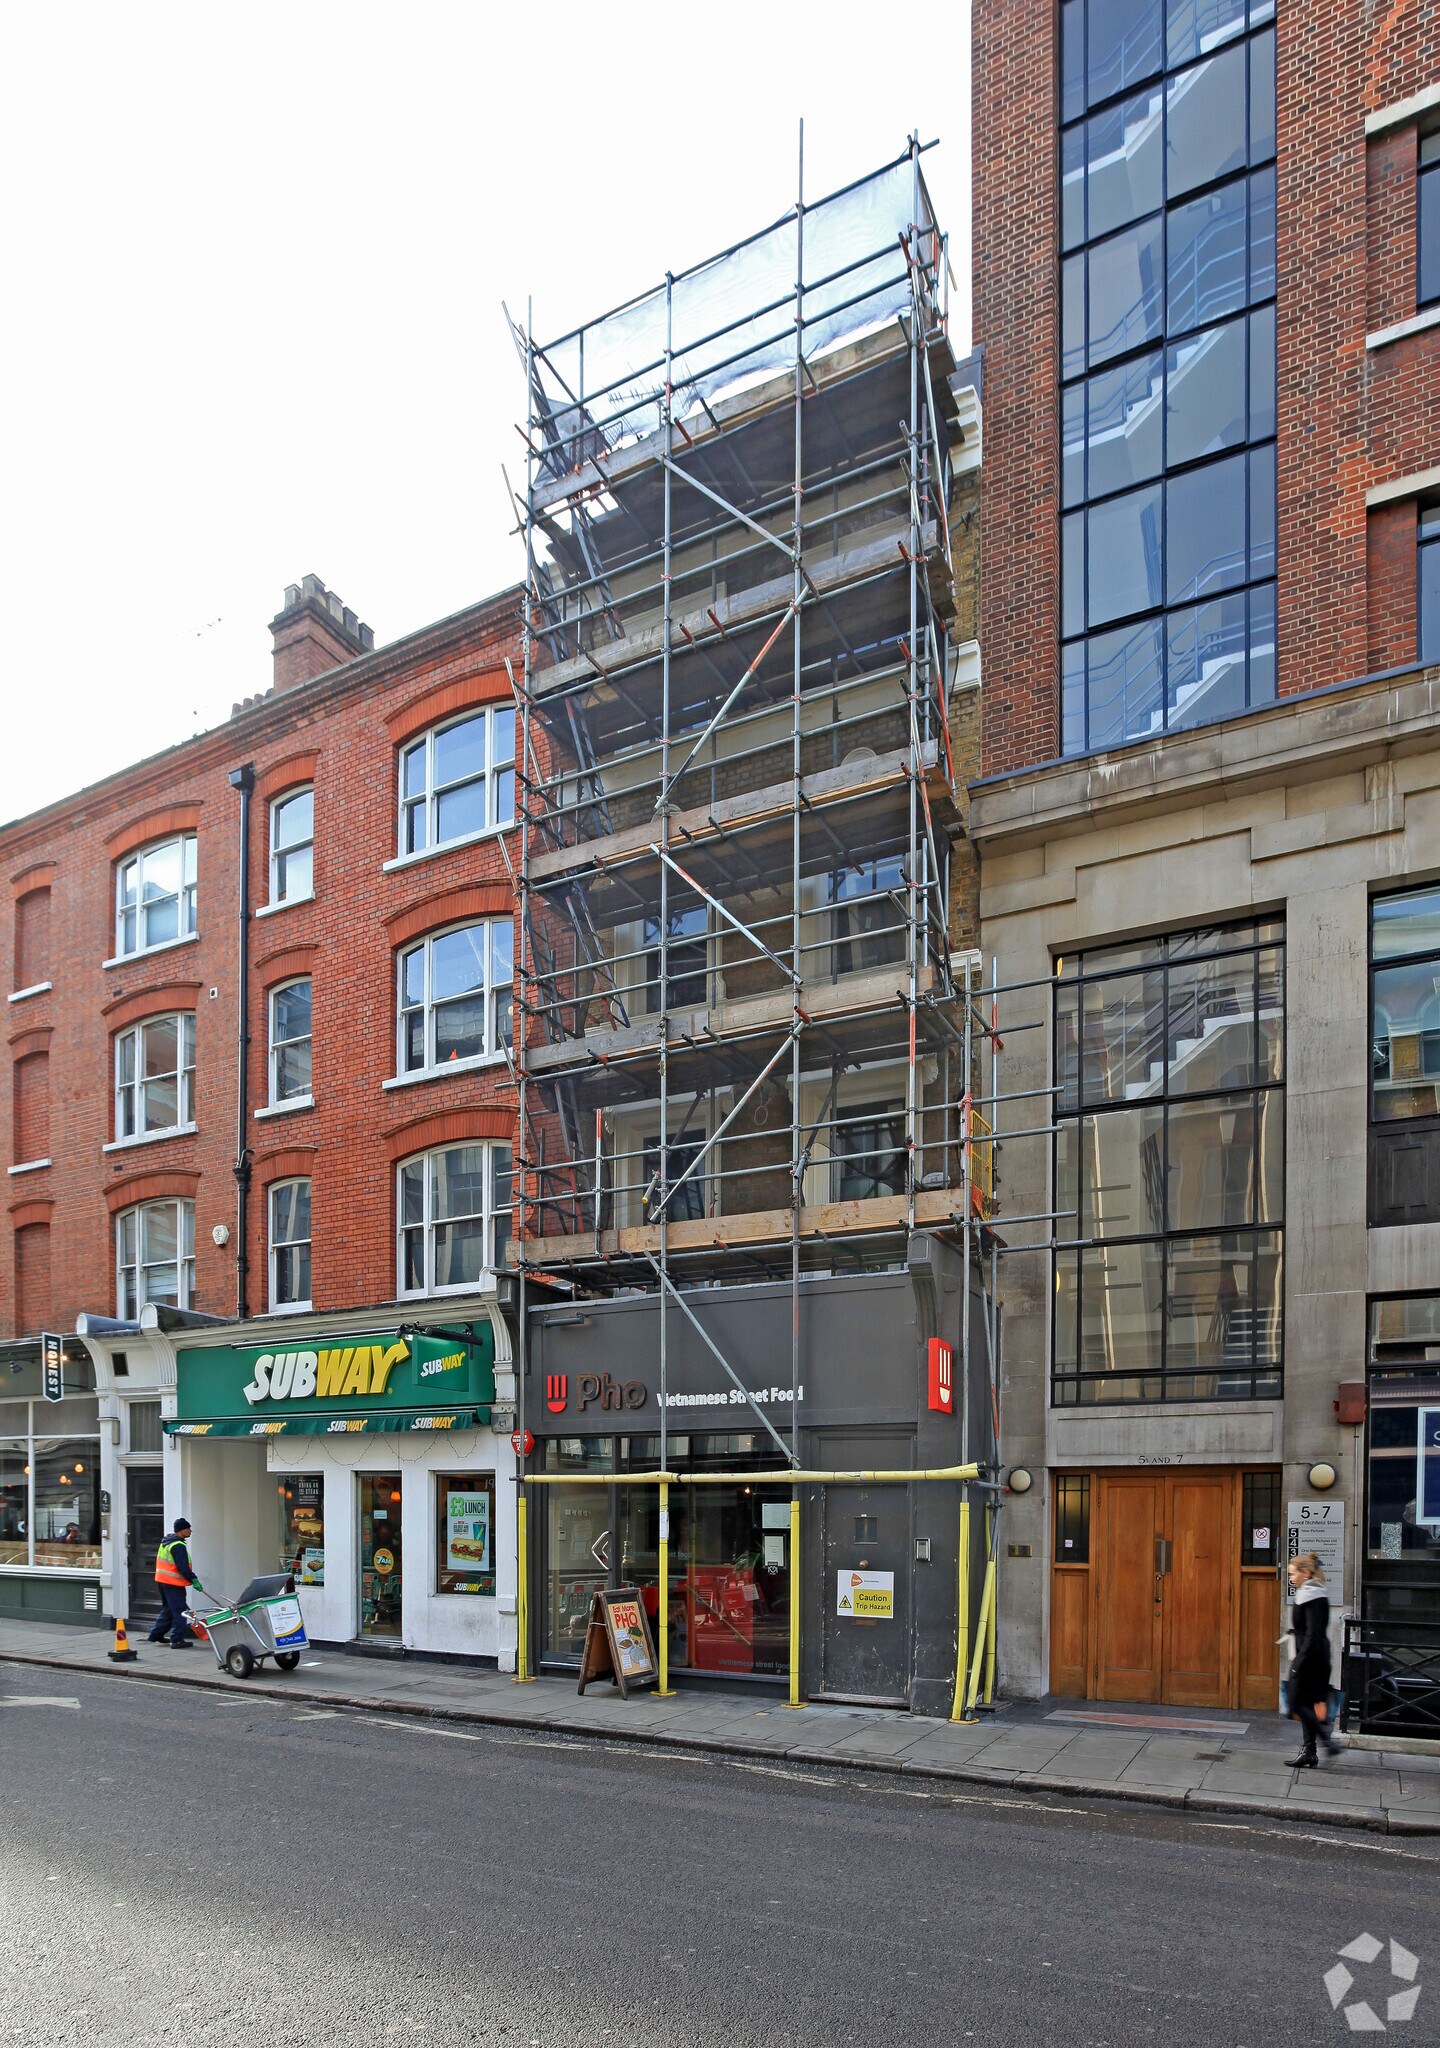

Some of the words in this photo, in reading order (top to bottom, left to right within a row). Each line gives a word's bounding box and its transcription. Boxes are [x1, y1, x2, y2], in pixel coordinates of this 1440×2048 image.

[47, 1340, 59, 1394] HONEST
[420, 1352, 467, 1377] SUBWAY
[243, 1339, 410, 1405] SUBWAY
[576, 1372, 646, 1411] Pho
[250, 1422, 287, 1434] SUBWAY
[327, 1419, 368, 1432] SUBWAY
[411, 1416, 456, 1429] SUBWAY
[174, 1424, 213, 1434] SUBWAY
[1176, 1454, 1183, 1463] 7
[450, 1496, 465, 1517] £3
[465, 1501, 486, 1514] LUNCH
[1290, 1528, 1298, 1538] 5
[1290, 1538, 1297, 1547] 4
[1290, 1548, 1297, 1557] 3
[453, 1583, 483, 1592] SUBWAY
[858, 1593, 888, 1602] Caution
[621, 1604, 635, 1612] More
[855, 1602, 868, 1610] Trip
[869, 1603, 891, 1611] Hazard
[614, 1611, 639, 1629] PHO
